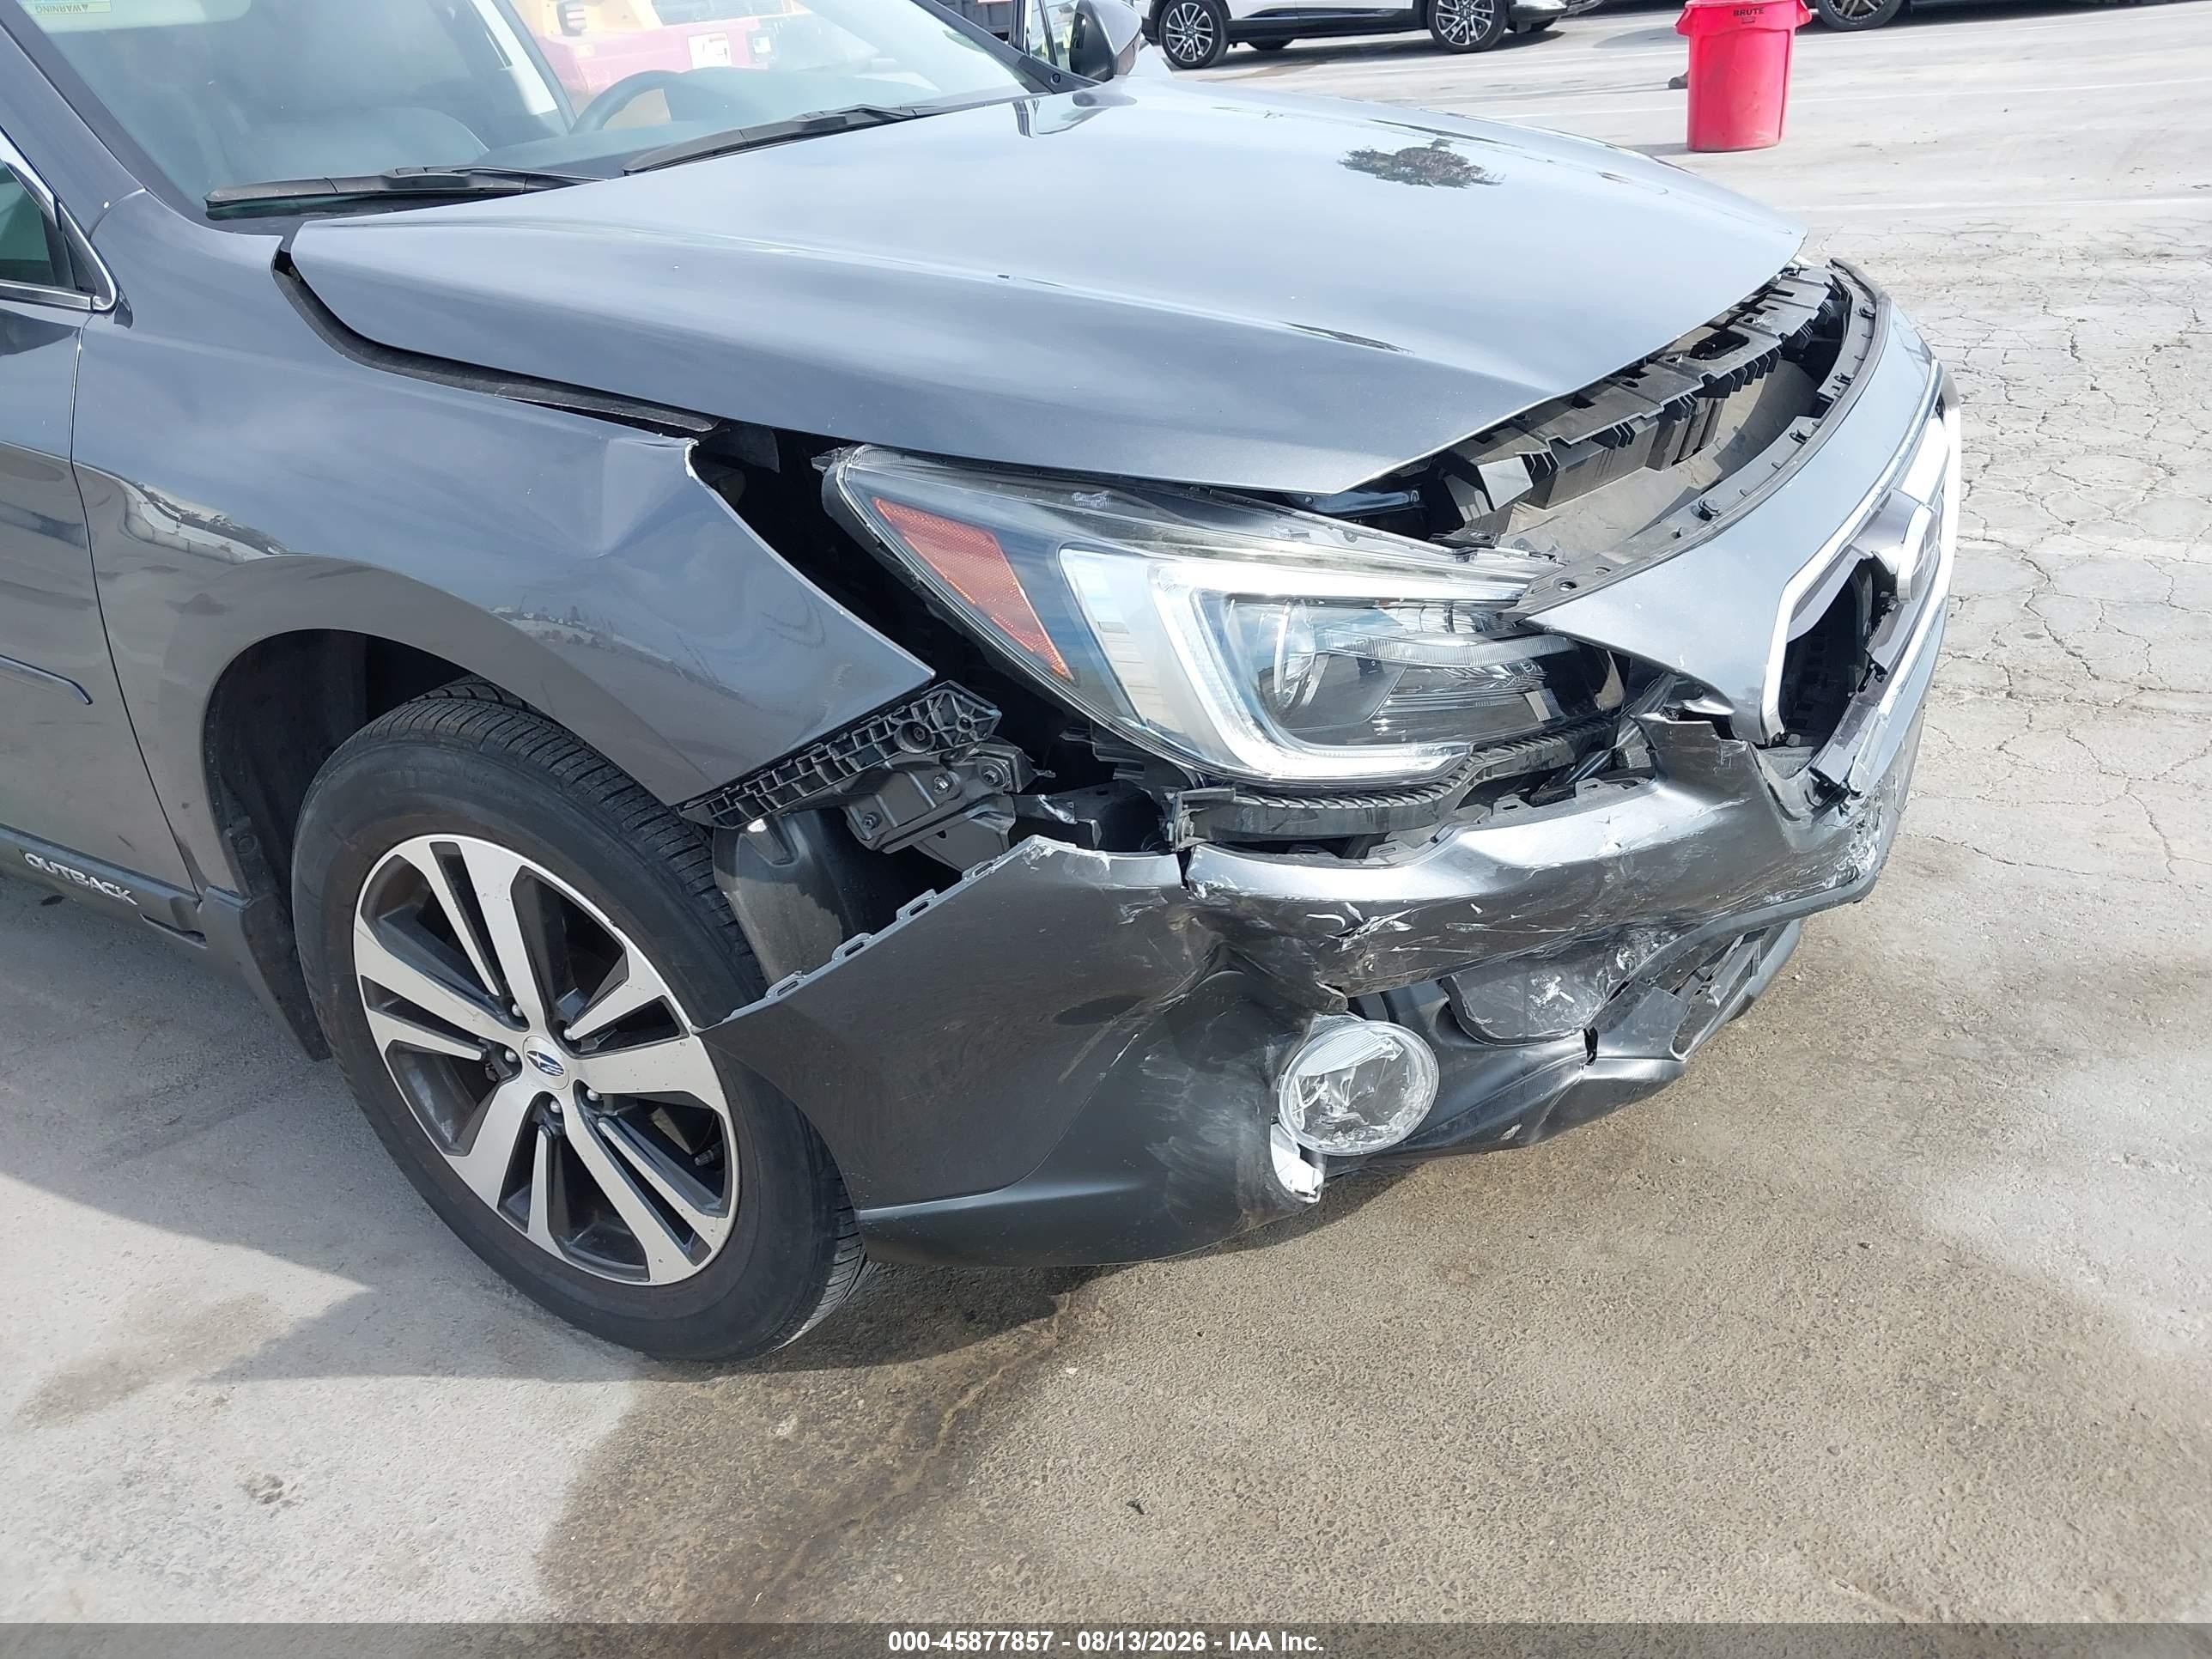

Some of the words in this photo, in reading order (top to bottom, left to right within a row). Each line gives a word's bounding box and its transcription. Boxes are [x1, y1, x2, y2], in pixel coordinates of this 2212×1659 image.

[35, 4, 82, 14] WARNING
[1734, 7, 1764, 16] BRUTE
[24, 852, 138, 906] OUTBACK
